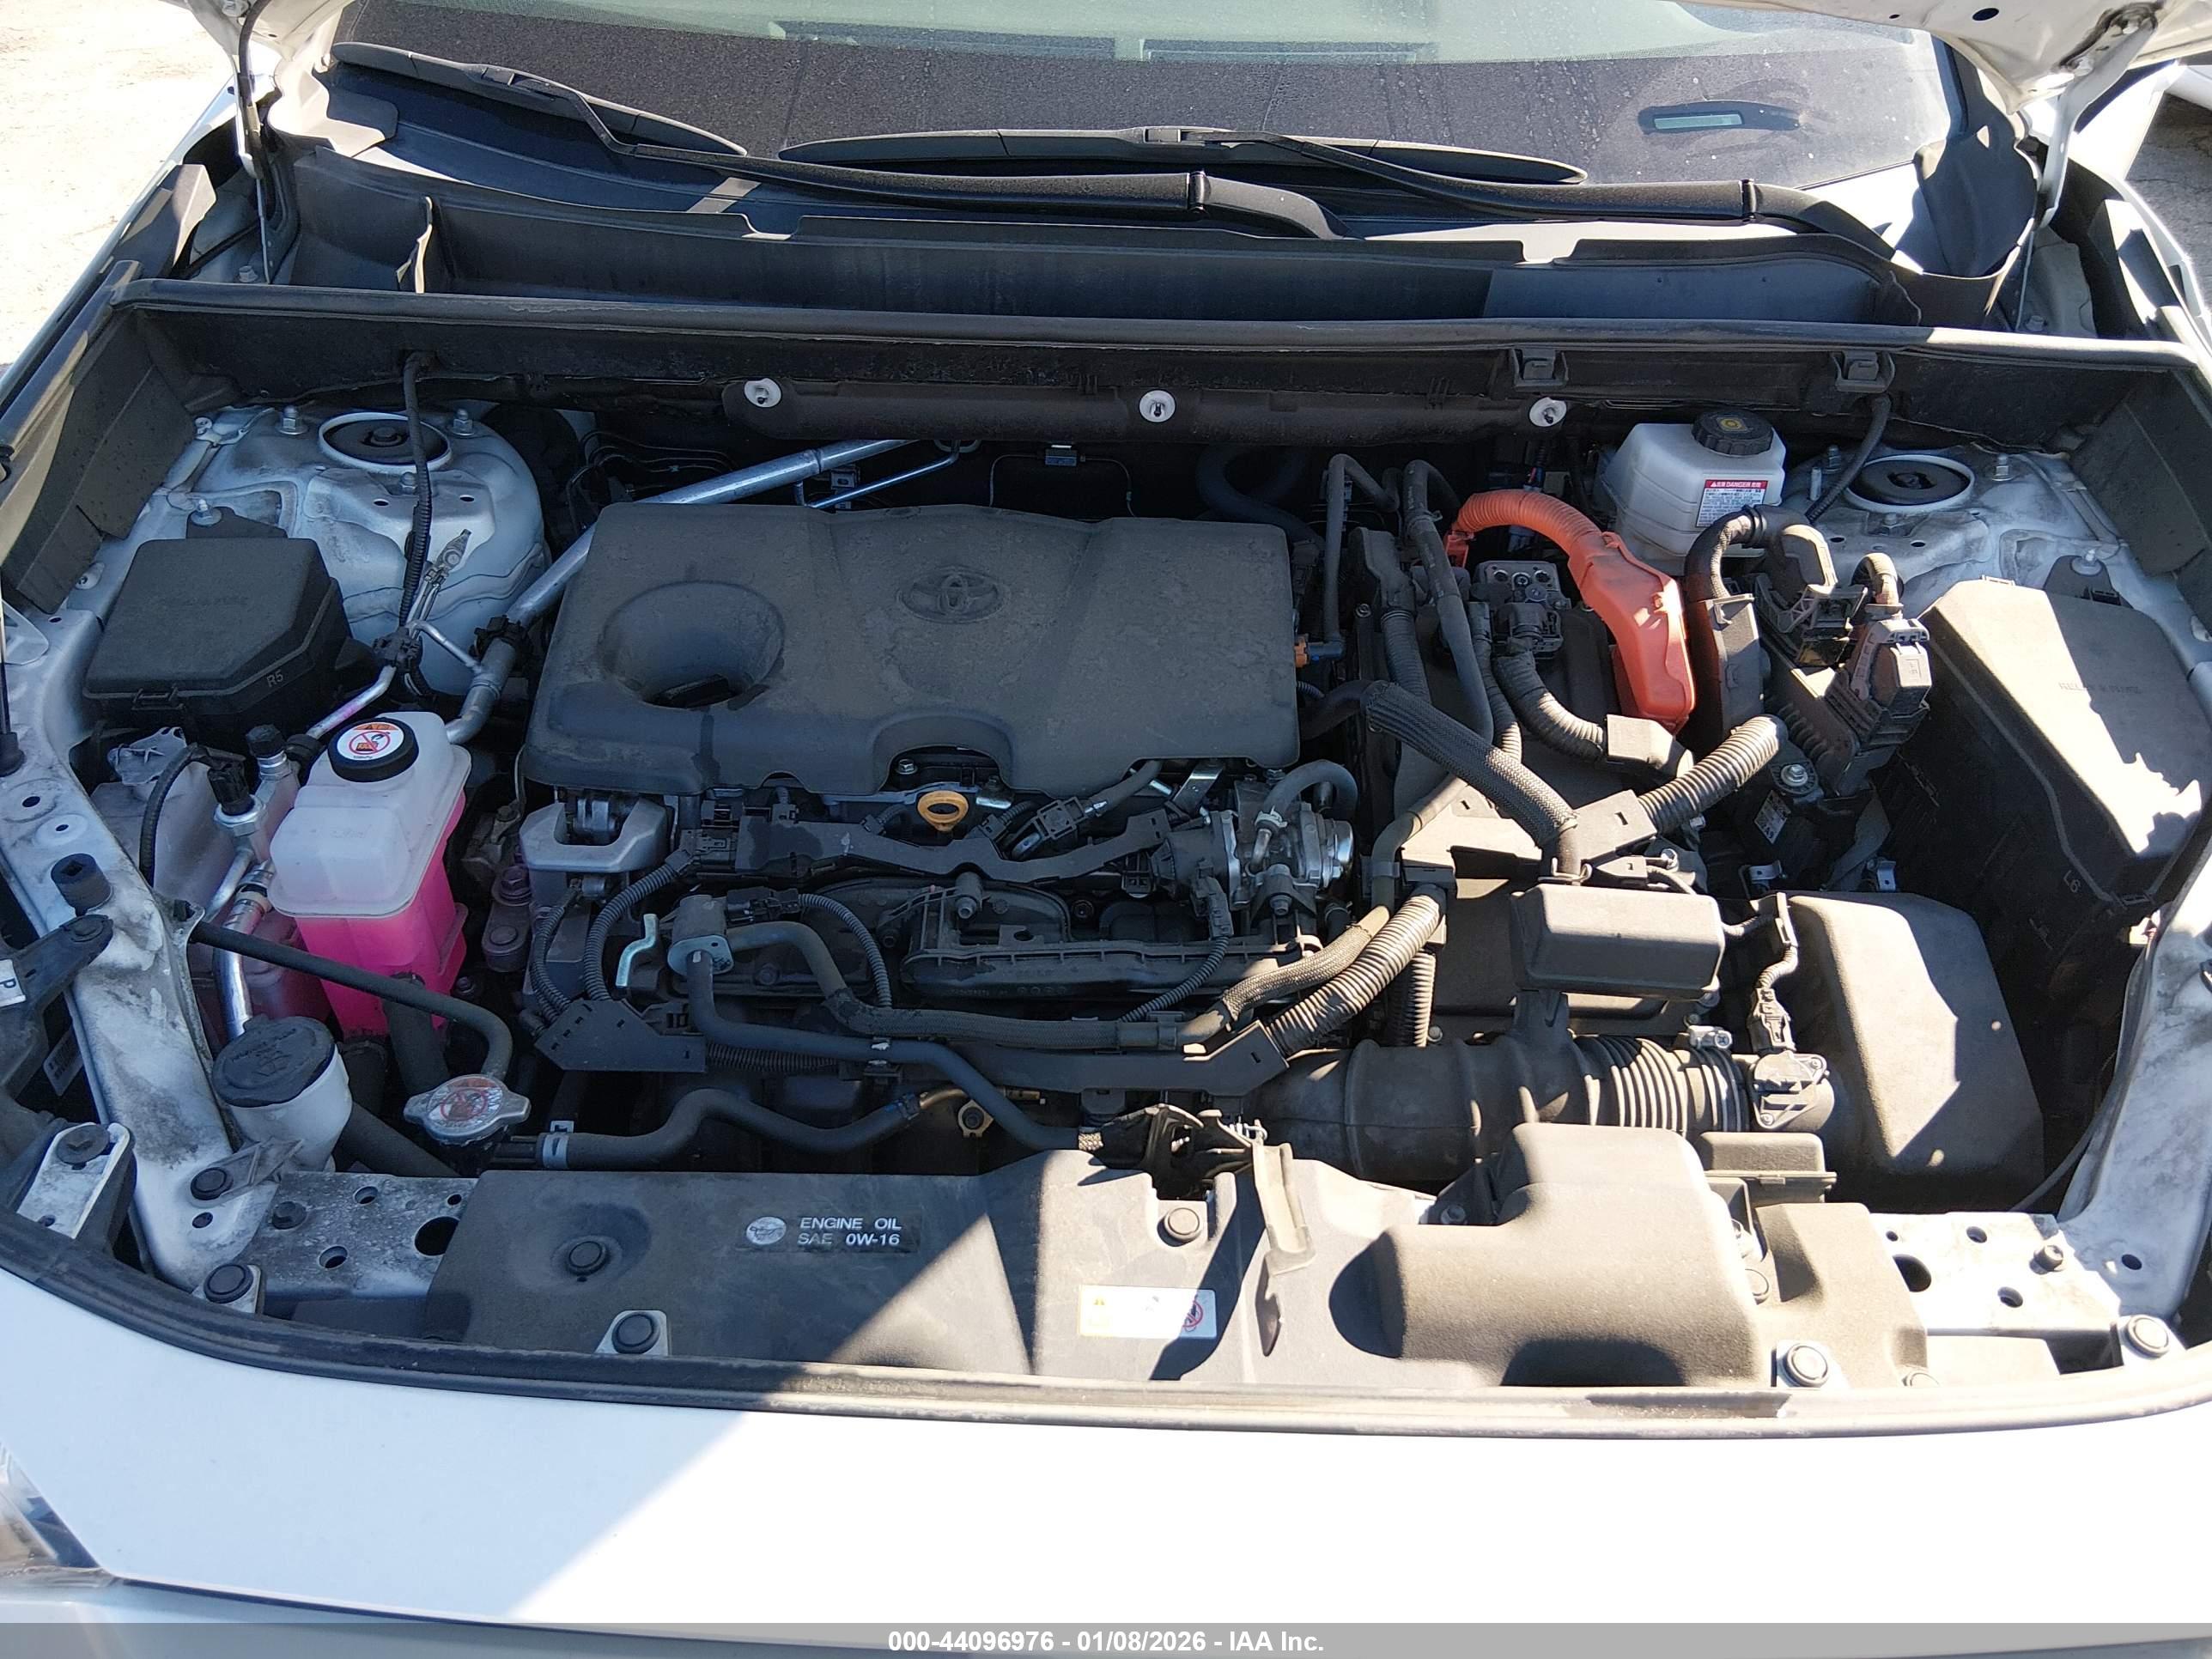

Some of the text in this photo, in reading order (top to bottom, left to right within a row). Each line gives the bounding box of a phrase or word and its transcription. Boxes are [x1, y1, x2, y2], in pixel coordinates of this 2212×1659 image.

[266, 669, 284, 688] R5
[2063, 870, 2081, 893] L6
[799, 1217, 902, 1231] ENGINE OIL
[797, 1233, 901, 1246] SAE 0W-16
